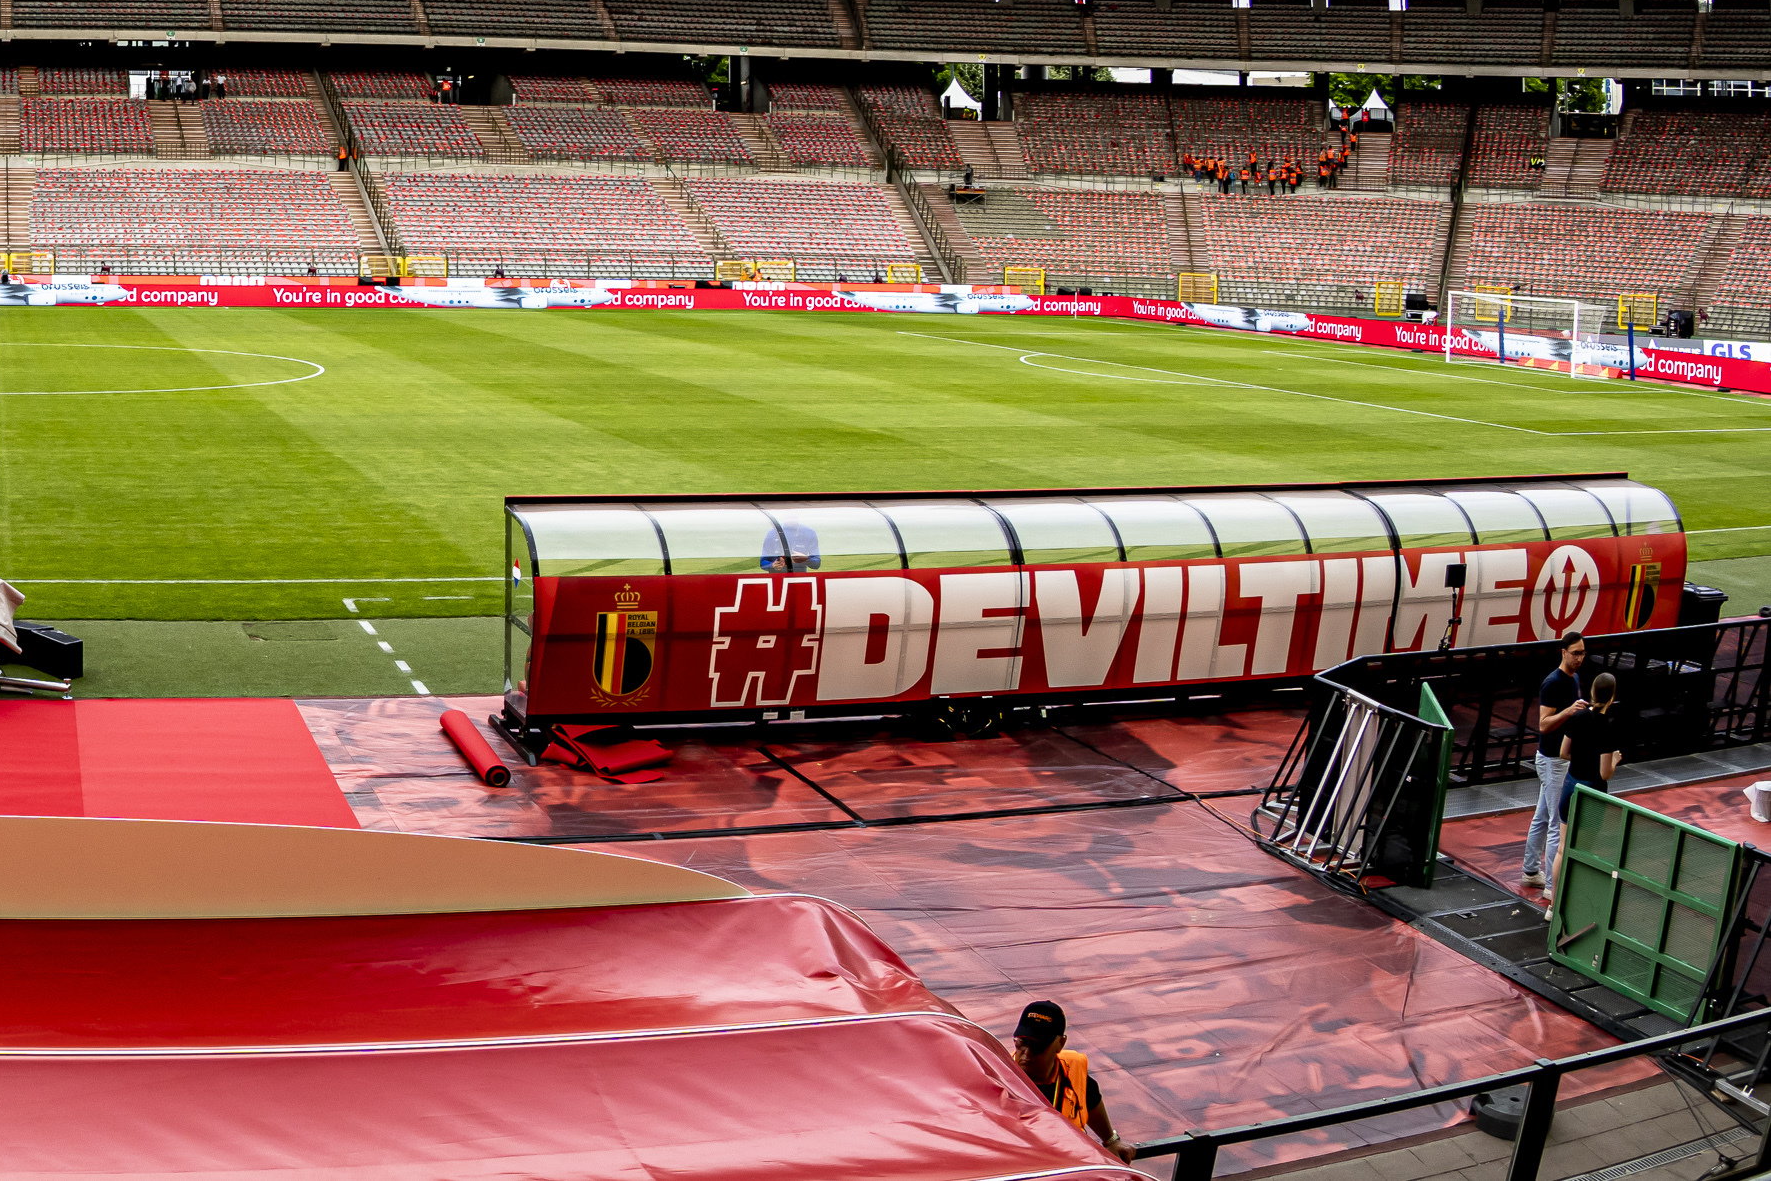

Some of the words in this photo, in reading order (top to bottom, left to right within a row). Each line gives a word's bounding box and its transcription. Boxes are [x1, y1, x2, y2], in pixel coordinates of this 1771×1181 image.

[141, 290, 218, 306] company
[272, 286, 322, 303] You're
[327, 289, 341, 303] in
[345, 289, 385, 307] good
[625, 294, 695, 309] company
[742, 290, 786, 306] You're
[789, 293, 803, 307] in
[806, 294, 840, 311] good
[1043, 301, 1101, 315] company
[1132, 300, 1156, 316] You're
[1157, 303, 1164, 317] in
[1166, 307, 1186, 321] good
[1317, 322, 1362, 340] company
[1395, 325, 1426, 346] You're
[1429, 330, 1438, 347] in
[1711, 343, 1752, 360] GLS
[1658, 359, 1722, 384] company
[710, 548, 1528, 707] #DEVILTIME
